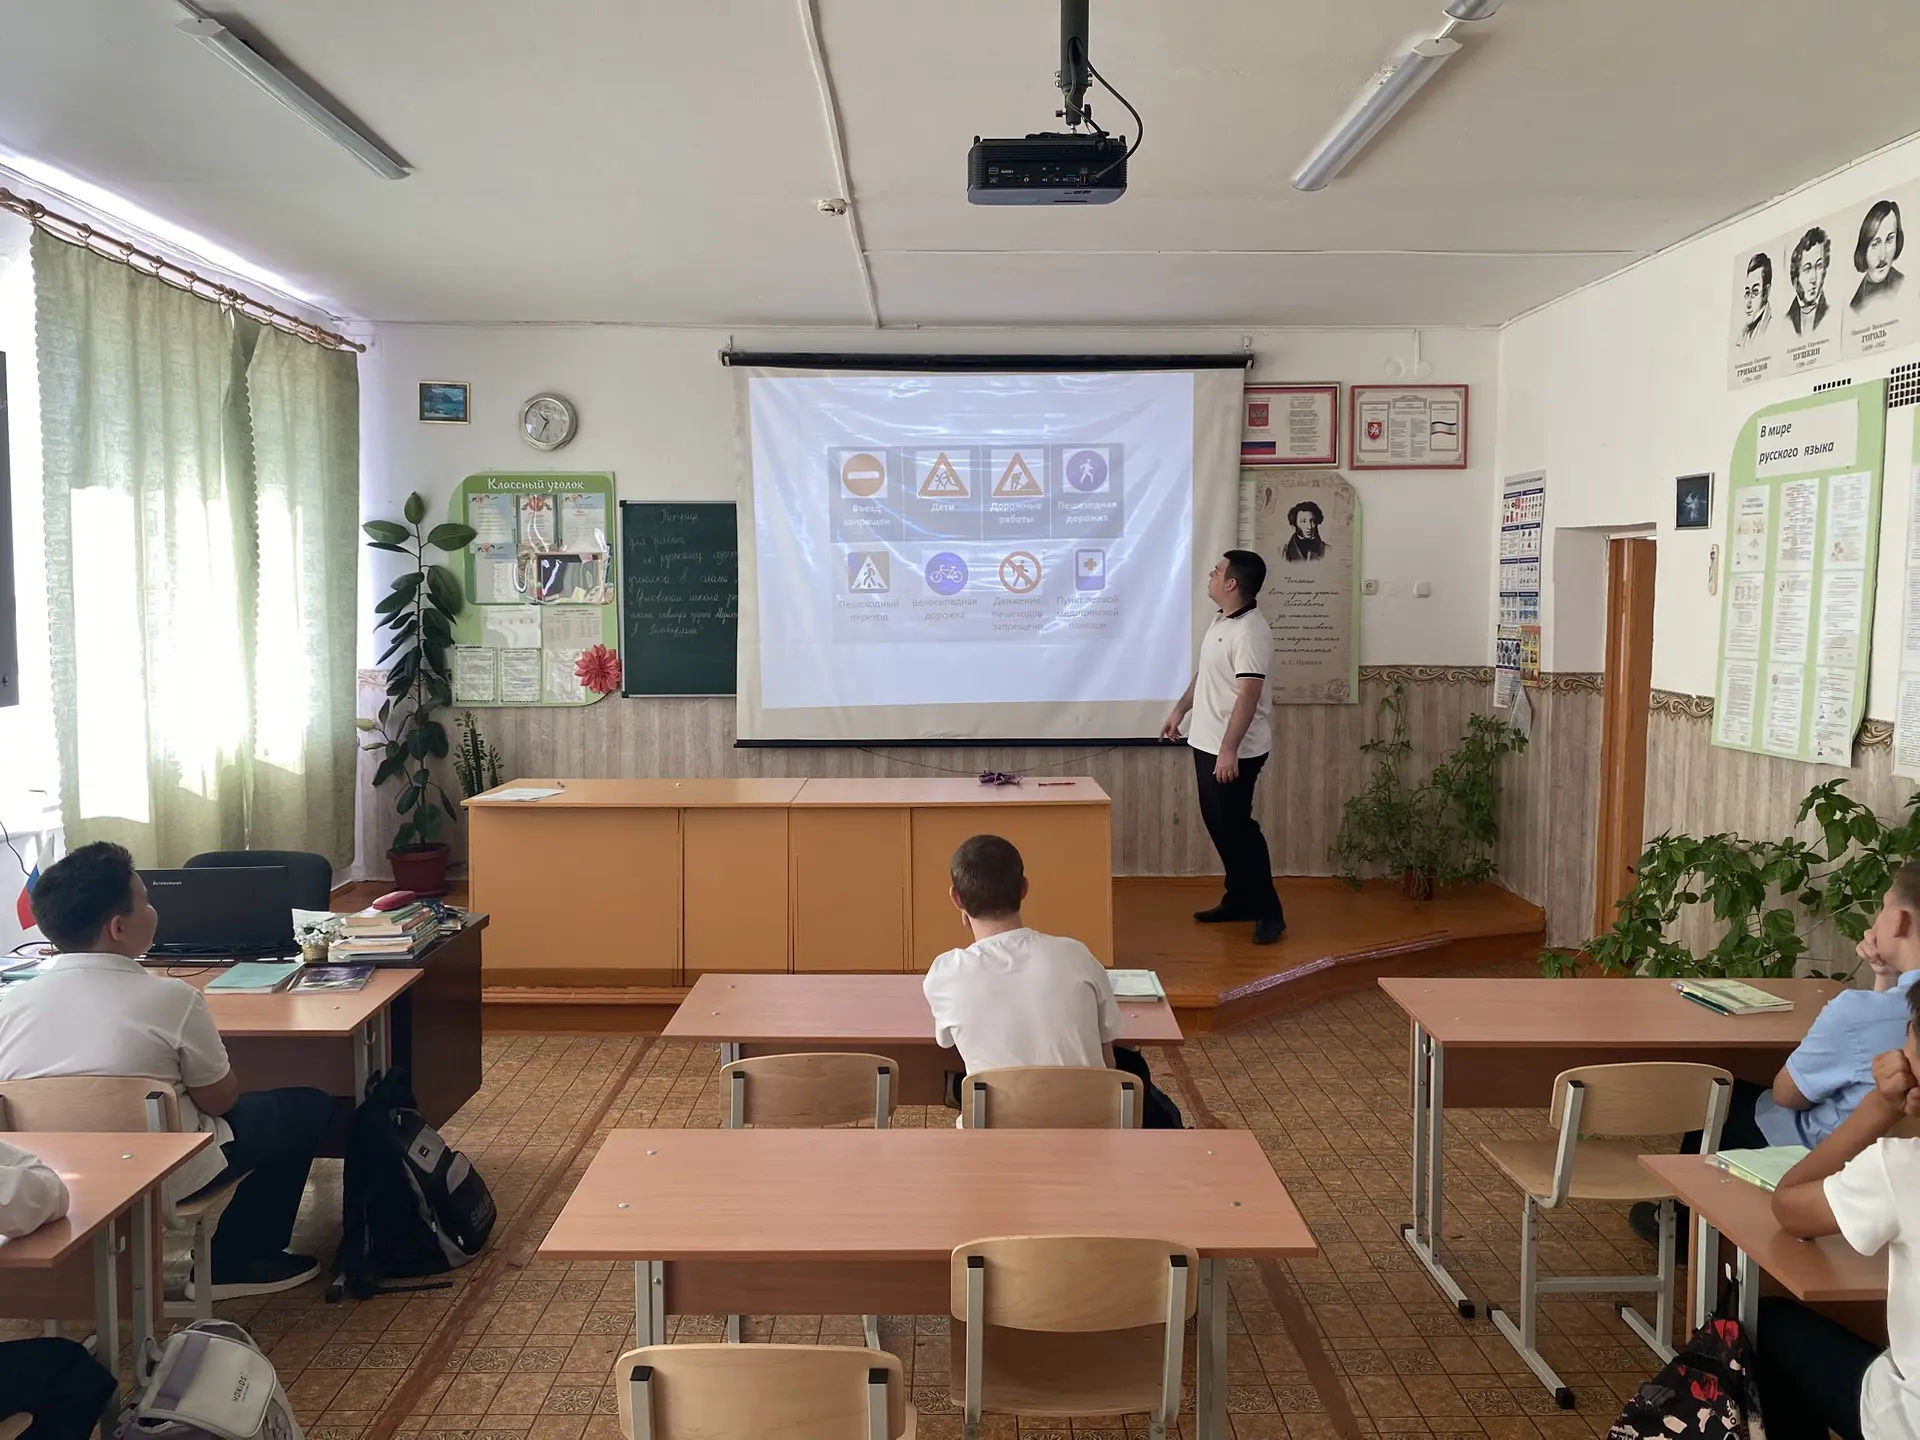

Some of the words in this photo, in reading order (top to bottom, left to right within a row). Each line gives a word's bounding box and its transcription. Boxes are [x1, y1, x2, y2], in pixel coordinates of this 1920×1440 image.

[1861, 330, 1887, 343] ГОГОЛЬ
[1792, 347, 1821, 362] ПУШКИН
[1737, 362, 1768, 378] ГРИБОЕДОВ
[1760, 425, 1766, 437] В
[1768, 423, 1792, 437] мире
[1759, 447, 1798, 465] русского
[1803, 441, 1834, 456] языка
[487, 478, 545, 490] Классный
[548, 480, 585, 492] уголок
[931, 503, 955, 512] Дети
[990, 502, 1042, 512] Дорожные
[999, 515, 1034, 525] работы
[993, 596, 1041, 606] Движение
